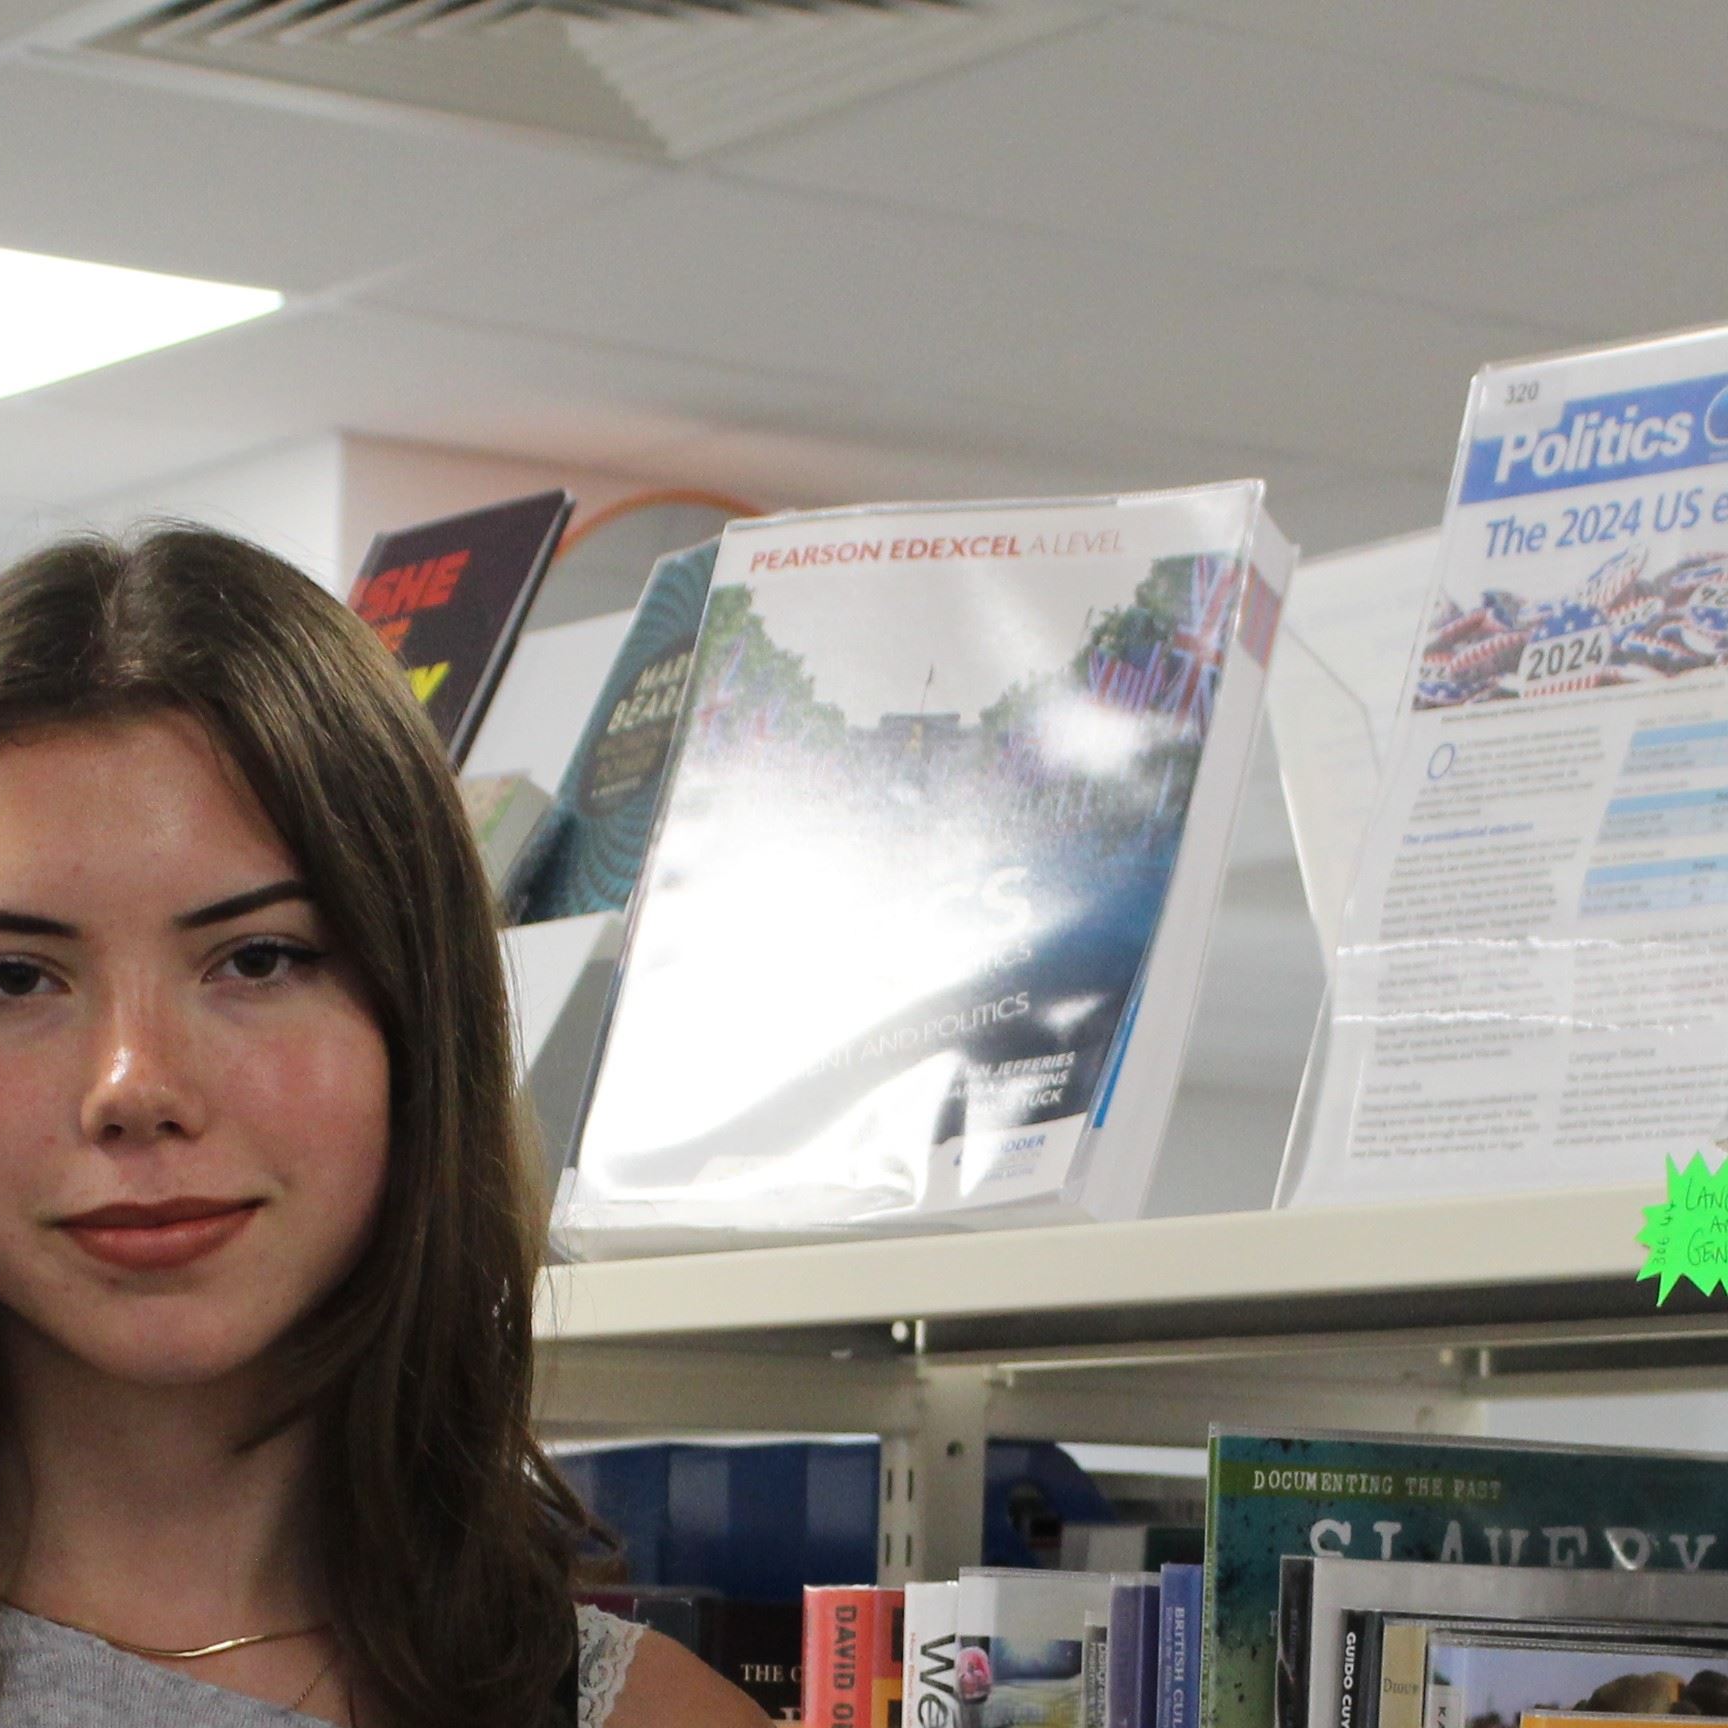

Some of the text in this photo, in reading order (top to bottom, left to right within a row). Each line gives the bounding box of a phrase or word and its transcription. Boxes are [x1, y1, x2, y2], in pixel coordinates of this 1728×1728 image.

[1505, 382, 1539, 404] 320
[1494, 407, 1697, 482] Politics
[750, 530, 1125, 571] PEARSON EDEXCEL A LEVEL
[1485, 514, 1547, 558] The
[1556, 507, 1640, 549] 2024
[1653, 494, 1700, 540] US
[1527, 637, 1604, 681] 2024
[923, 992, 1029, 1041] POLITICS
[993, 1052, 1075, 1076] JEFFERIES
[1252, 1469, 1392, 1496] DOCUMENTING
[831, 1604, 857, 1693] DAVID
[1172, 1606, 1186, 1682] BRITISH
[1342, 1631, 1357, 1691] GUIDO
